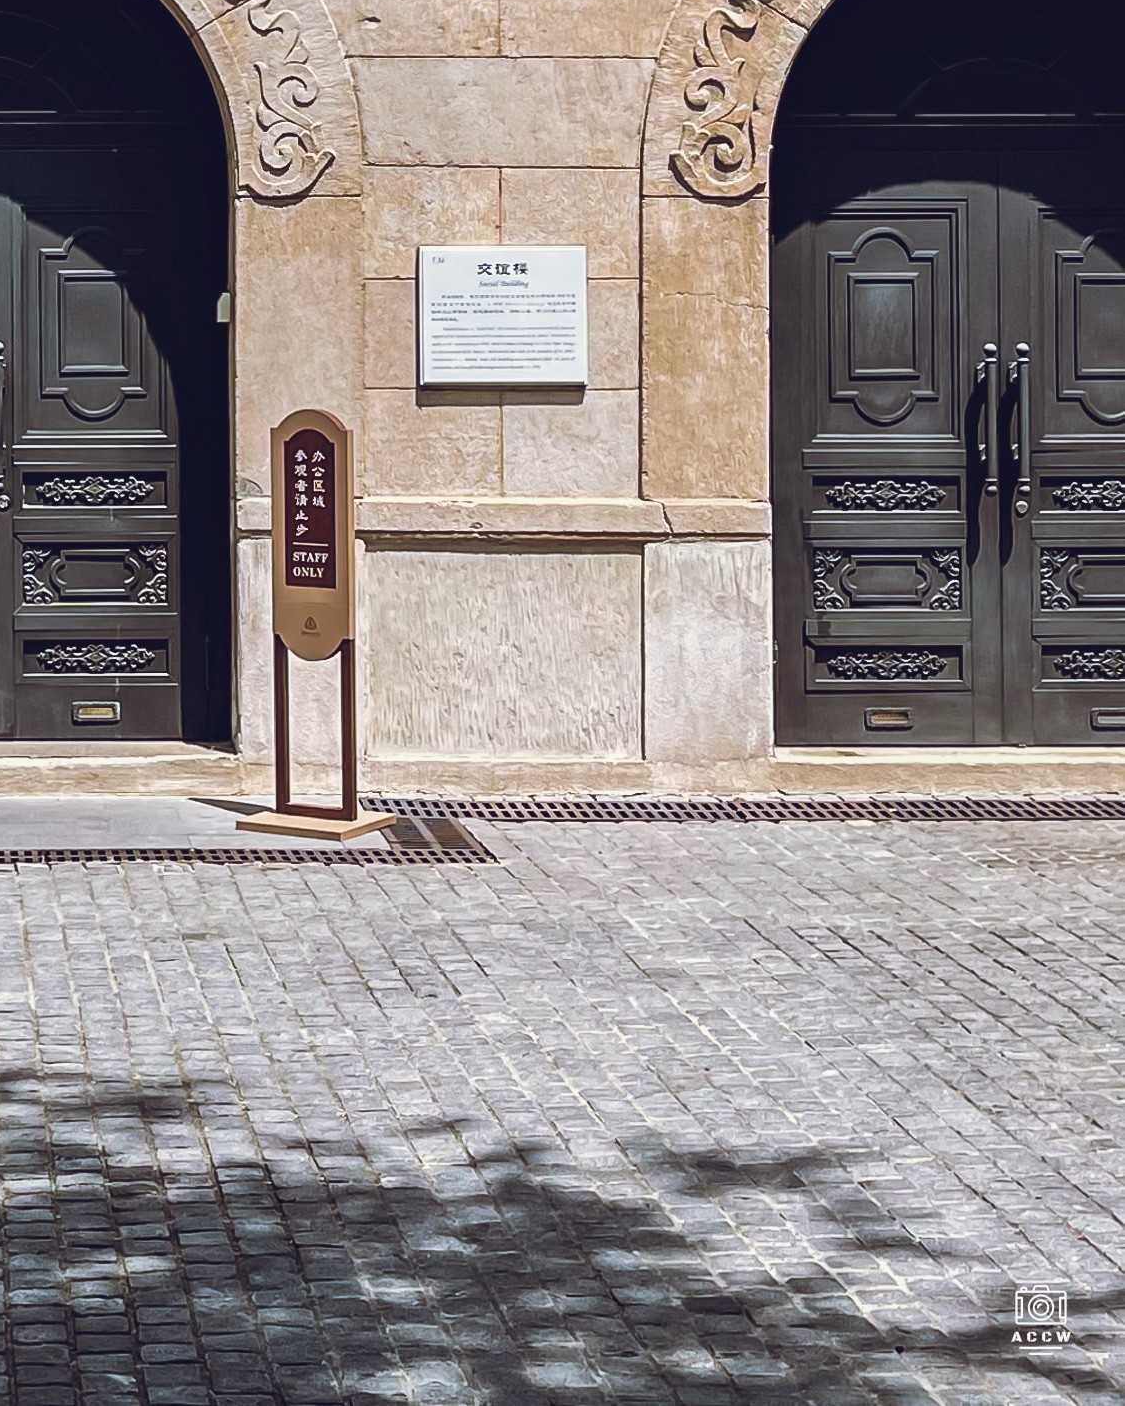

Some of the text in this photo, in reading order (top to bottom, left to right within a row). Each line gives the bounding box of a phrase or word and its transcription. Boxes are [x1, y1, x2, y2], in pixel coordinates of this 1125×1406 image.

[294, 449, 309, 536] 参观者请止步
[311, 450, 325, 508] 办公区域
[293, 551, 329, 563] STAFF
[293, 566, 324, 578] ONLY
